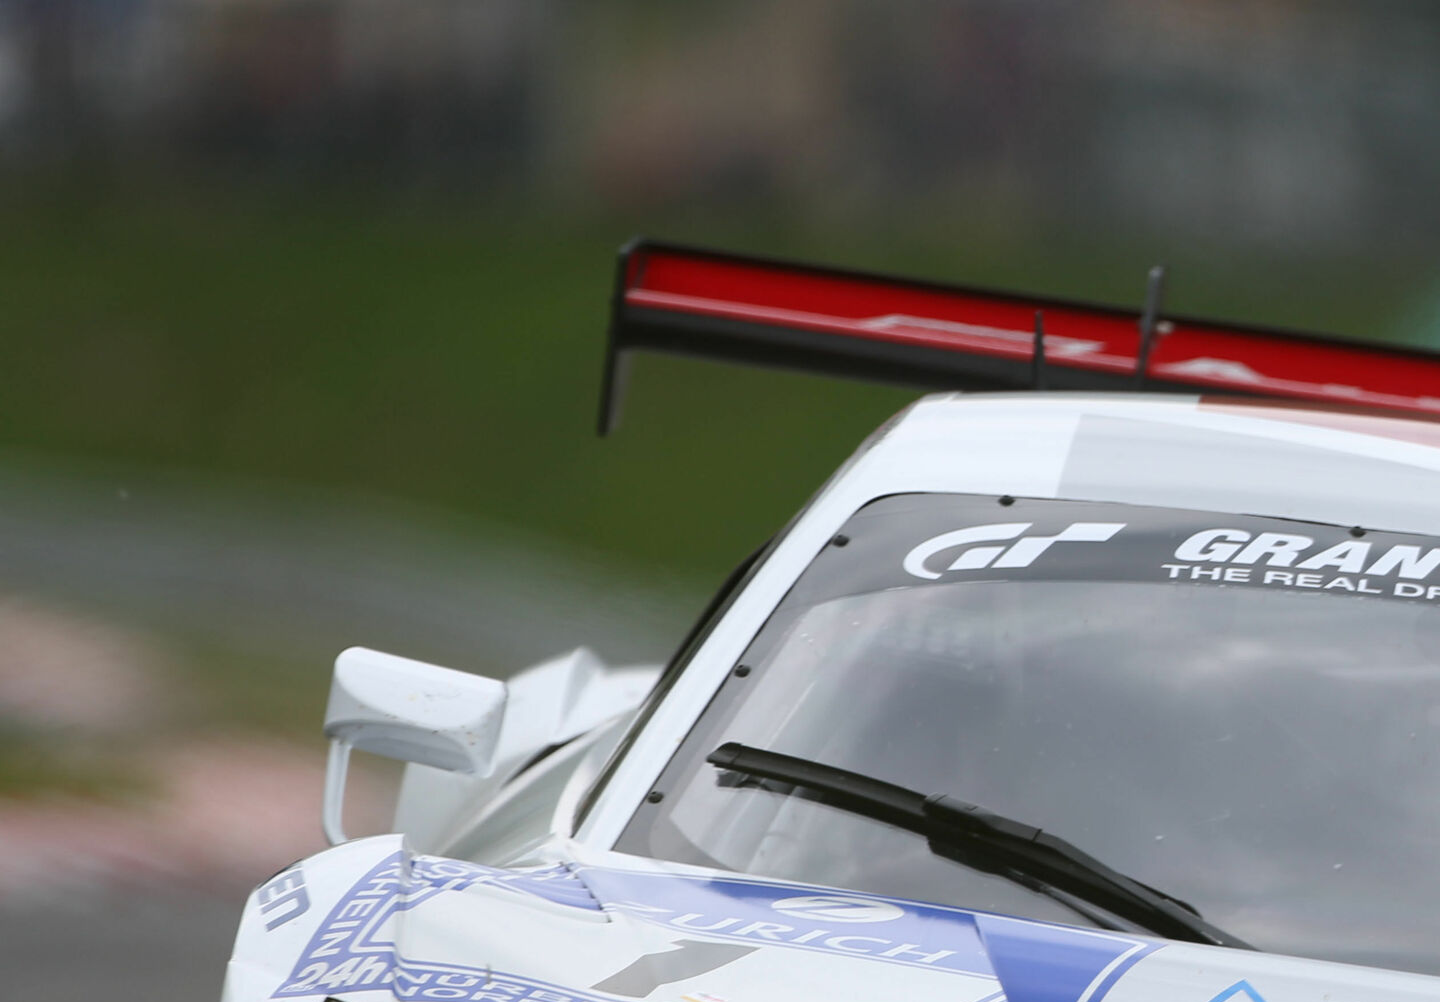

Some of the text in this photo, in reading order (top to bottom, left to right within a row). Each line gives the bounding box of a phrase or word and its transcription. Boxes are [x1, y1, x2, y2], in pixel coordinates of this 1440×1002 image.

[1161, 564, 1250, 583] THE
[1264, 571, 1382, 595] REAL
[603, 901, 957, 964] ZURICH
